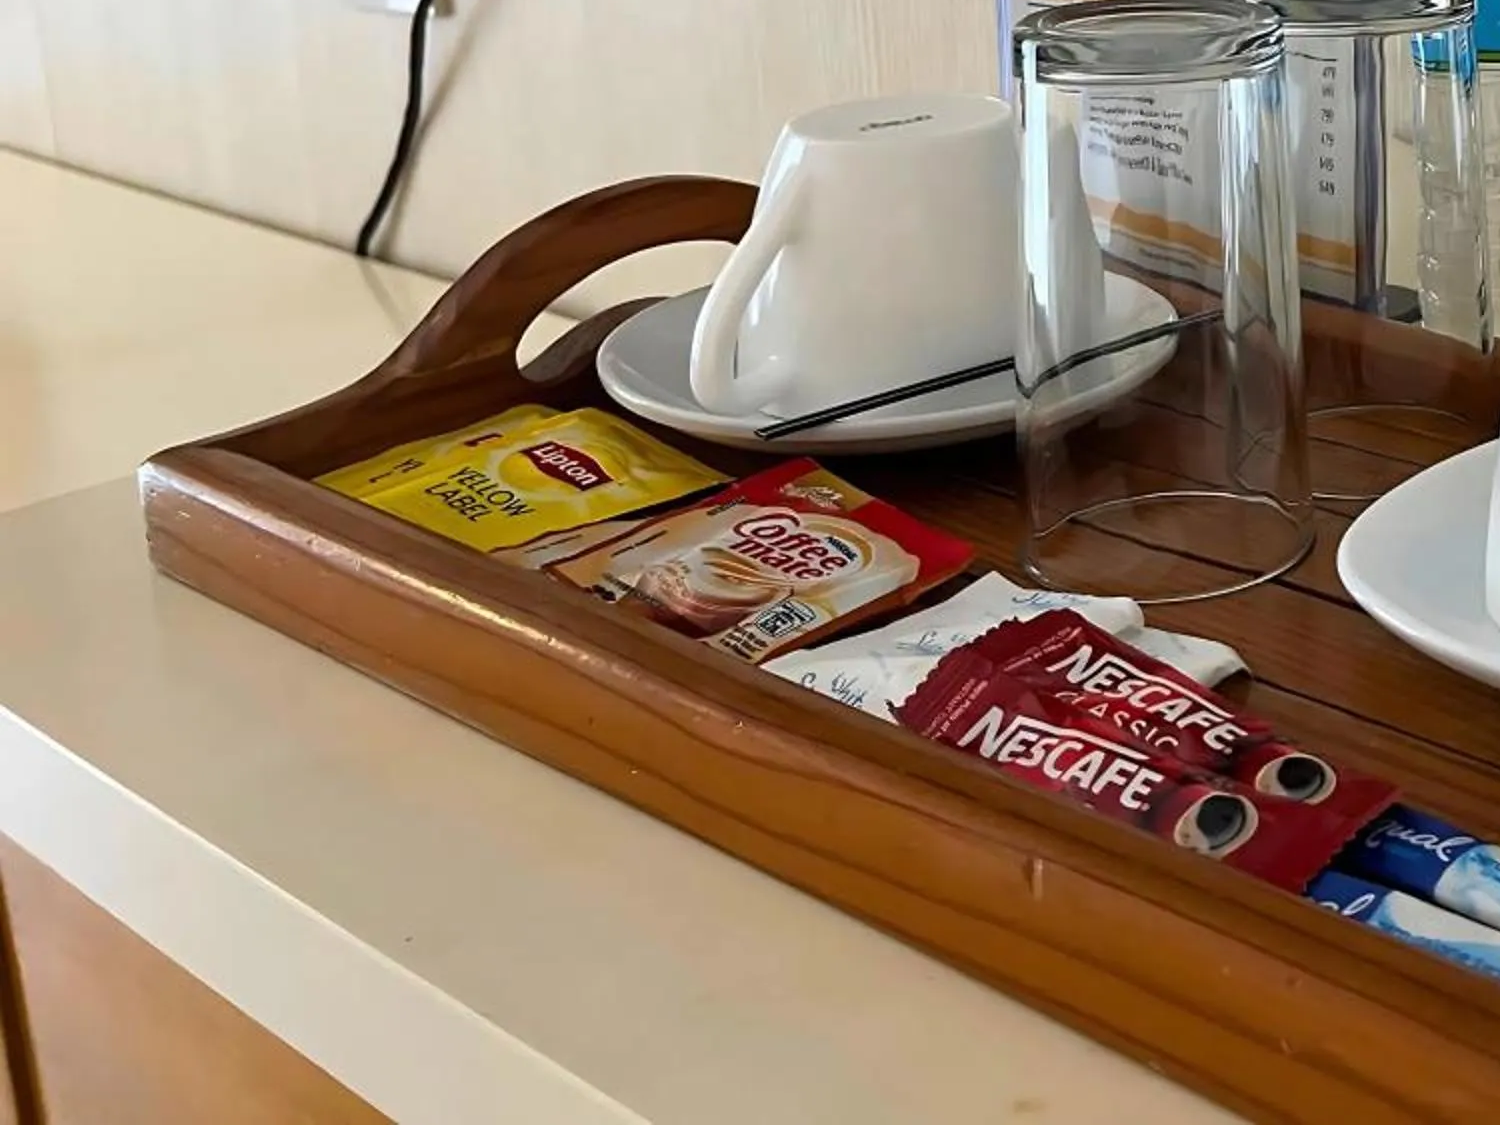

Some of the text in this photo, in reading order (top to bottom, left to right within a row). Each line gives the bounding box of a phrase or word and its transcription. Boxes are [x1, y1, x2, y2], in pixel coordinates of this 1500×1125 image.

[531, 443, 600, 486] Lipton
[424, 482, 493, 523] LABEL
[447, 466, 536, 517] YELLOW
[728, 537, 825, 580] mate
[732, 512, 848, 572] Coffee
